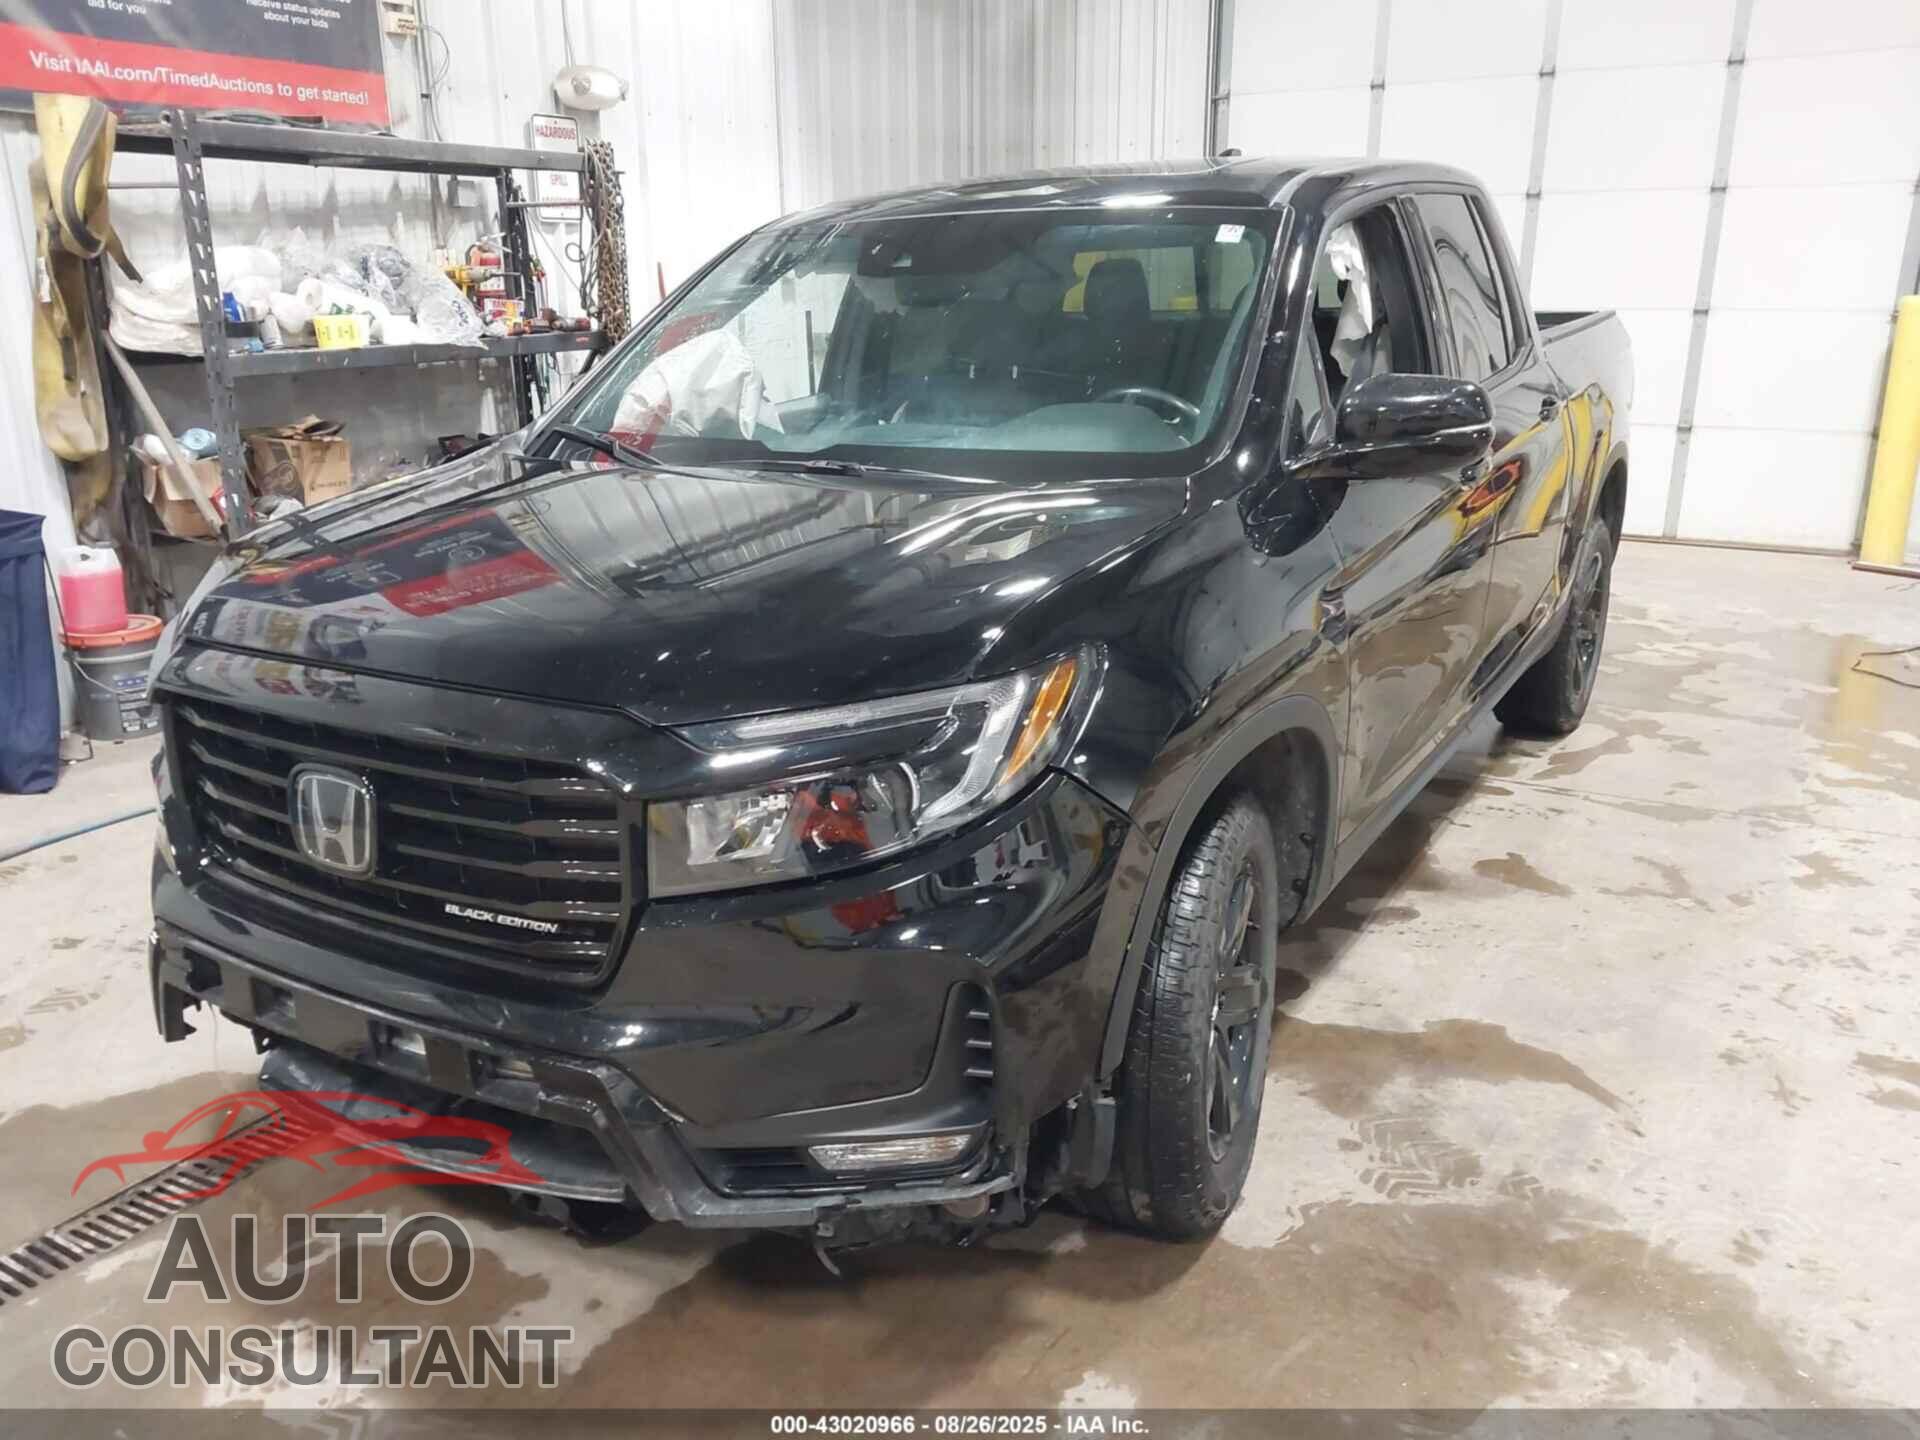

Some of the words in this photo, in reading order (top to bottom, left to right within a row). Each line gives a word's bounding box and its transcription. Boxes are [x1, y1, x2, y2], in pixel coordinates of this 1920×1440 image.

[107, 0, 123, 10] for
[127, 4, 147, 16] you
[283, 2, 308, 13] status
[309, 6, 341, 19] updates
[263, 11, 289, 22] about
[290, 15, 310, 25] your
[310, 17, 329, 28] bids
[29, 49, 73, 73] Visit
[74, 57, 274, 96] IAAI.com/TimedAuctions
[277, 83, 293, 97] to
[297, 85, 321, 102] get
[321, 88, 369, 106] started!
[444, 903, 494, 923] BLACK
[496, 914, 559, 934] EDITION
